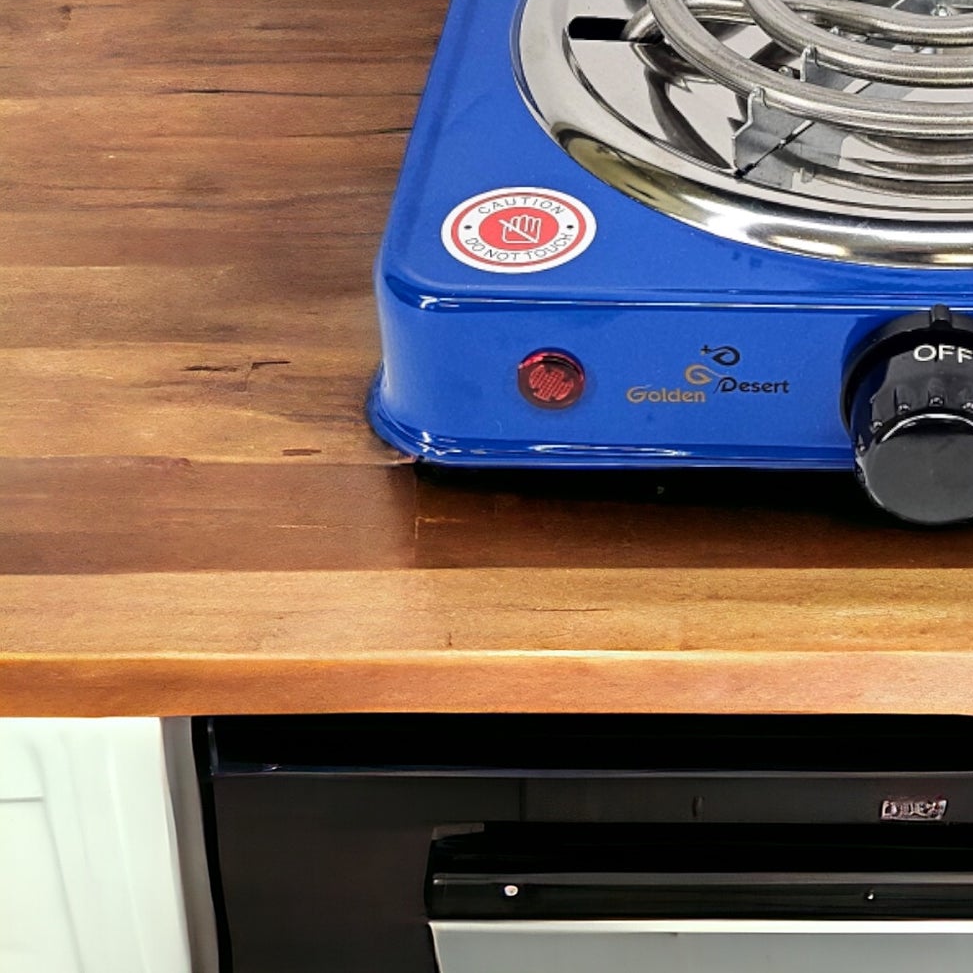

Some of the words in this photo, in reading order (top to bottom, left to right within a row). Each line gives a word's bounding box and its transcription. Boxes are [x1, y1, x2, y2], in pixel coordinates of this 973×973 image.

[478, 196, 565, 215] CAUTION
[465, 237, 486, 252] DO
[484, 249, 521, 262] NOT
[523, 232, 574, 260] TOUCH
[913, 344, 973, 364] OFF
[626, 384, 706, 403] Golden
[712, 377, 790, 394] Desert
